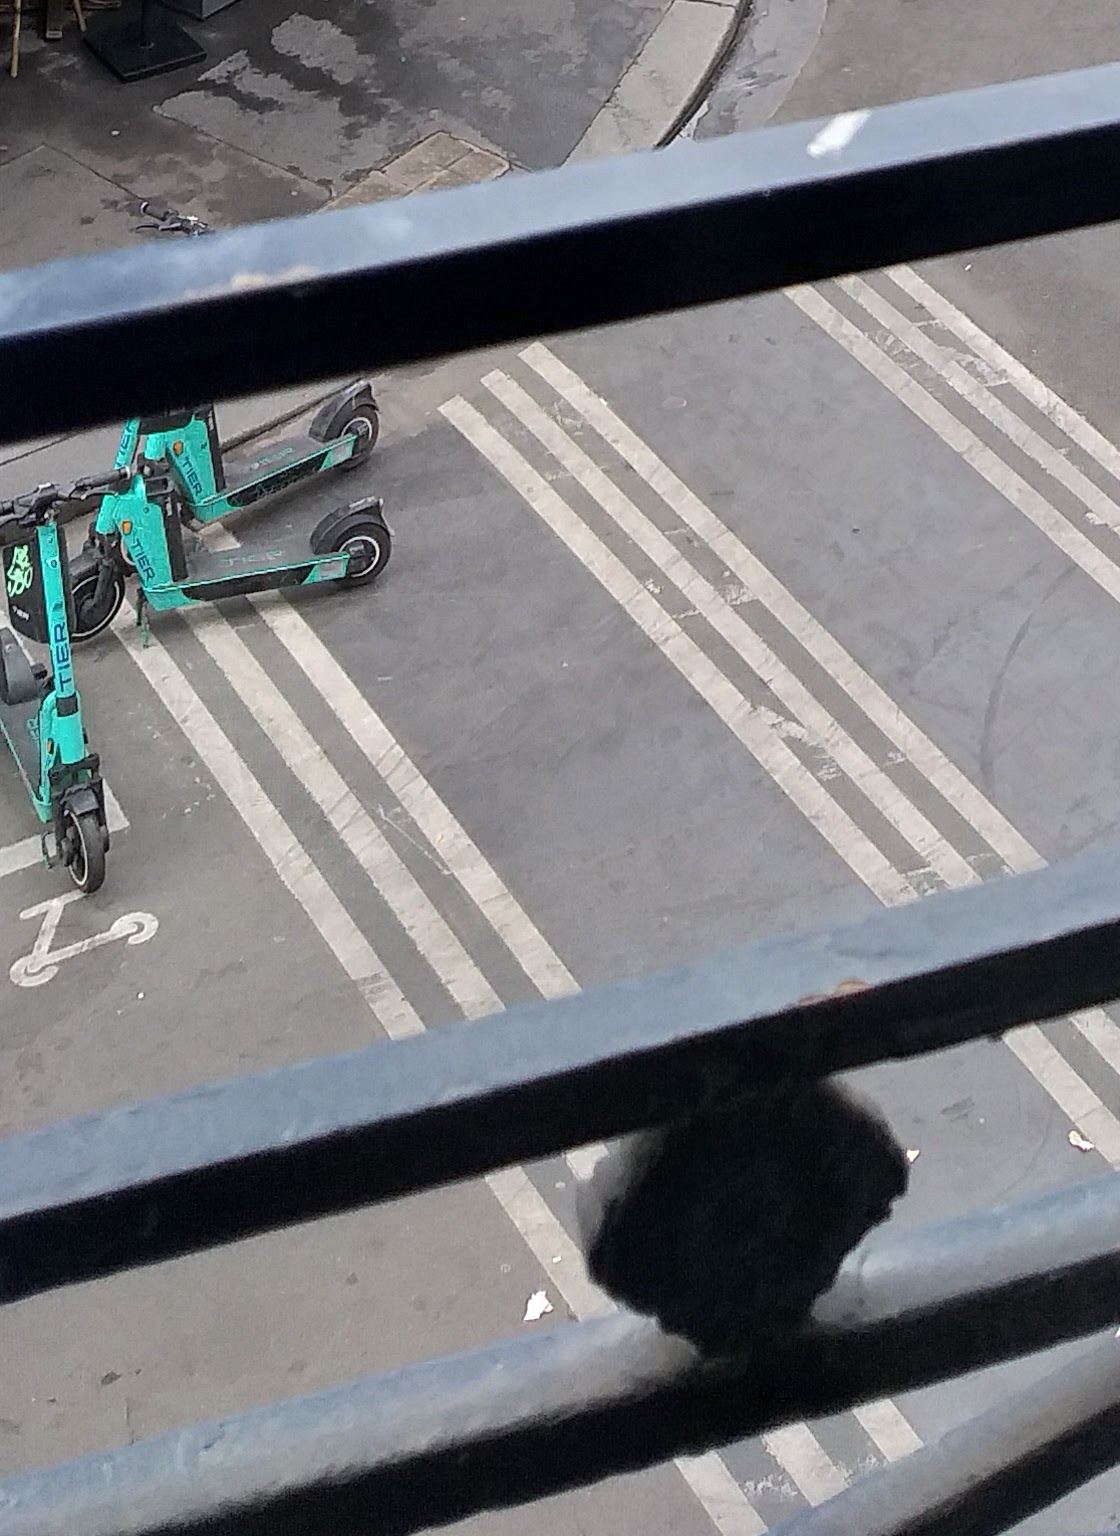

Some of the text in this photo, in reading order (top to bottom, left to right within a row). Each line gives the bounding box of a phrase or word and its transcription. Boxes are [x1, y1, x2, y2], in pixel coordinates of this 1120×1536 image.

[182, 455, 203, 497] TIER
[129, 538, 156, 583] TIER
[53, 620, 72, 693] TIER
